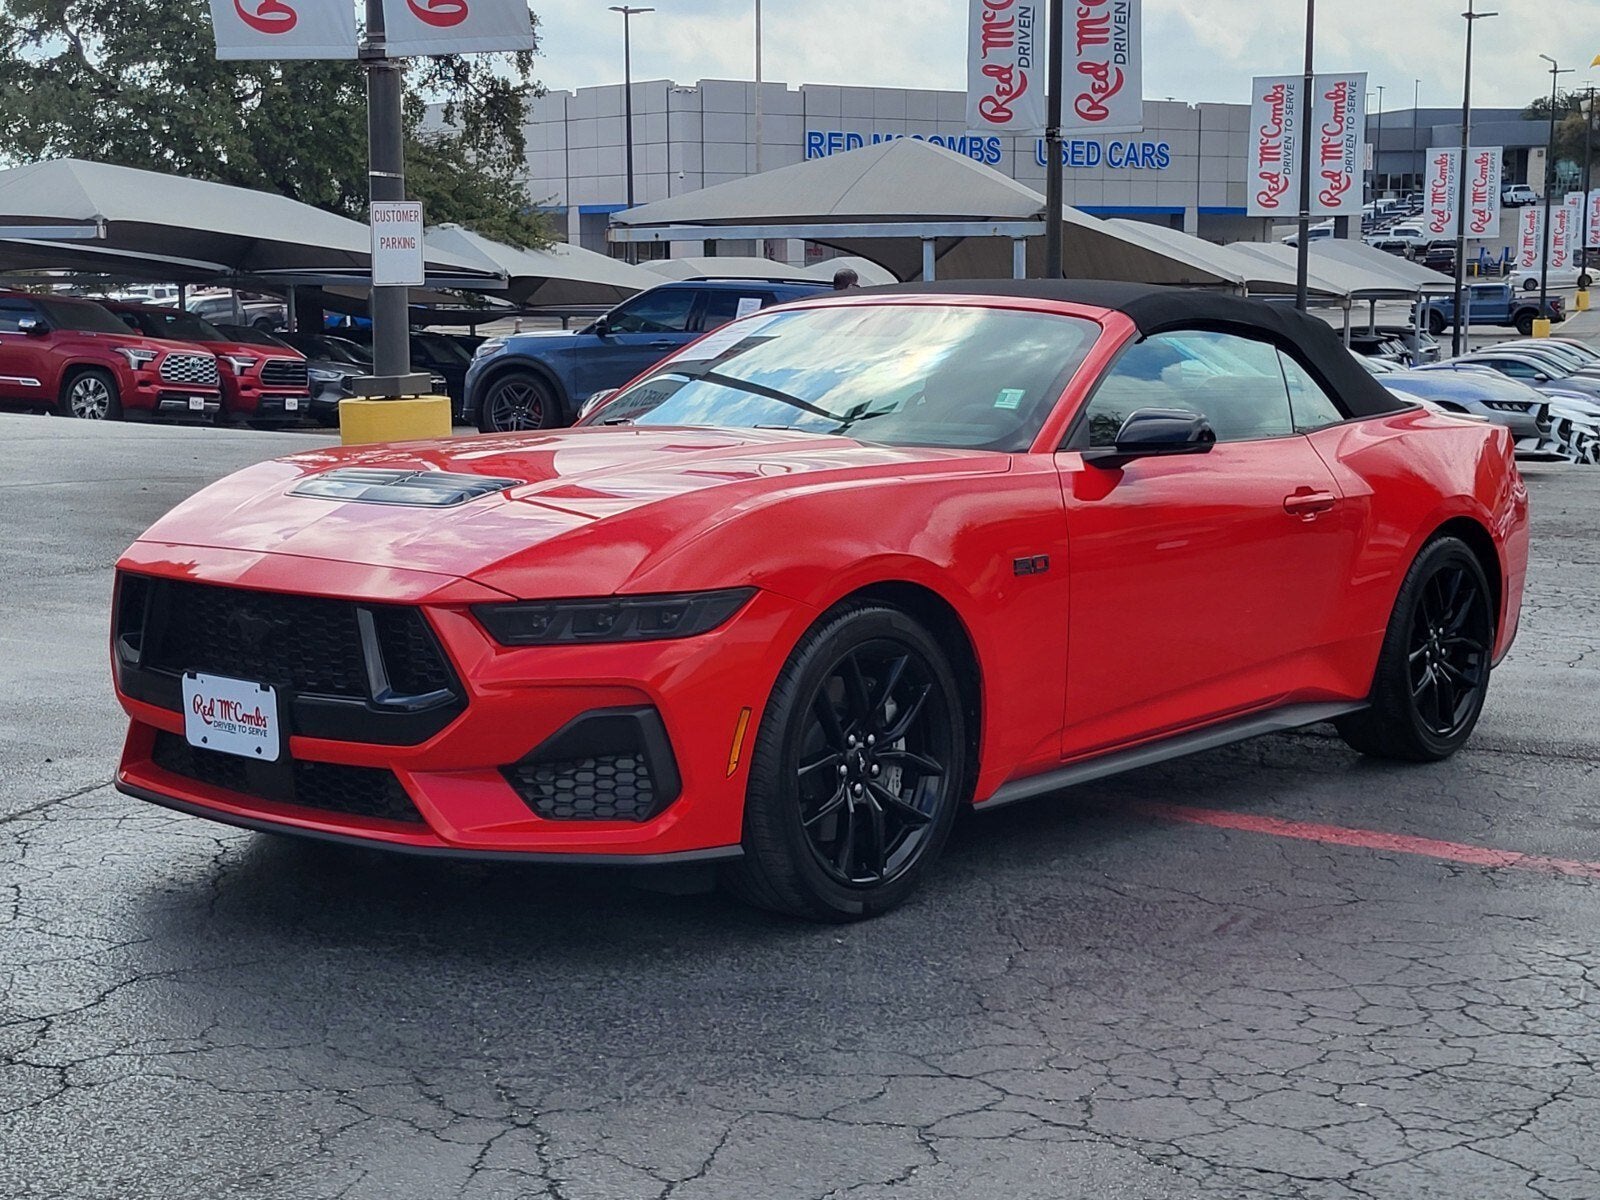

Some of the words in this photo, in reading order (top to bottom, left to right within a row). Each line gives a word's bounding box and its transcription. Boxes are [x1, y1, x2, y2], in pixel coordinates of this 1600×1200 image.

[1018, 6, 1031, 68] DRIVEN
[1114, 1, 1127, 65] DRIVEN
[979, 64, 1028, 123] Red
[1074, 60, 1124, 121] Red
[1285, 83, 1295, 116] SERVE
[1347, 81, 1357, 113] SERVE
[1259, 84, 1285, 168] McCombs
[1284, 118, 1294, 133] TO
[1321, 81, 1347, 167] McCombs
[1346, 116, 1355, 131] TO
[808, 131, 864, 159] RED
[1108, 141, 1170, 168] CARS
[1283, 136, 1292, 175] DRIVEN
[1345, 133, 1354, 174] DRIVEN
[1256, 171, 1289, 208] Red
[1318, 170, 1351, 207] Red
[1431, 153, 1448, 206] McCombs
[1448, 175, 1454, 185] TO
[1472, 152, 1489, 206] McCombs
[1488, 175, 1495, 185] TO
[374, 209, 420, 223] CUSTOMER
[1429, 209, 1451, 233] Red
[1470, 209, 1492, 233] Red
[380, 236, 416, 250] PARKING
[192, 694, 215, 725] Red
[216, 699, 268, 728] McCombs
[213, 720, 237, 731] DRIVEN
[238, 725, 247, 734] TO
[248, 727, 268, 738] SERVE
